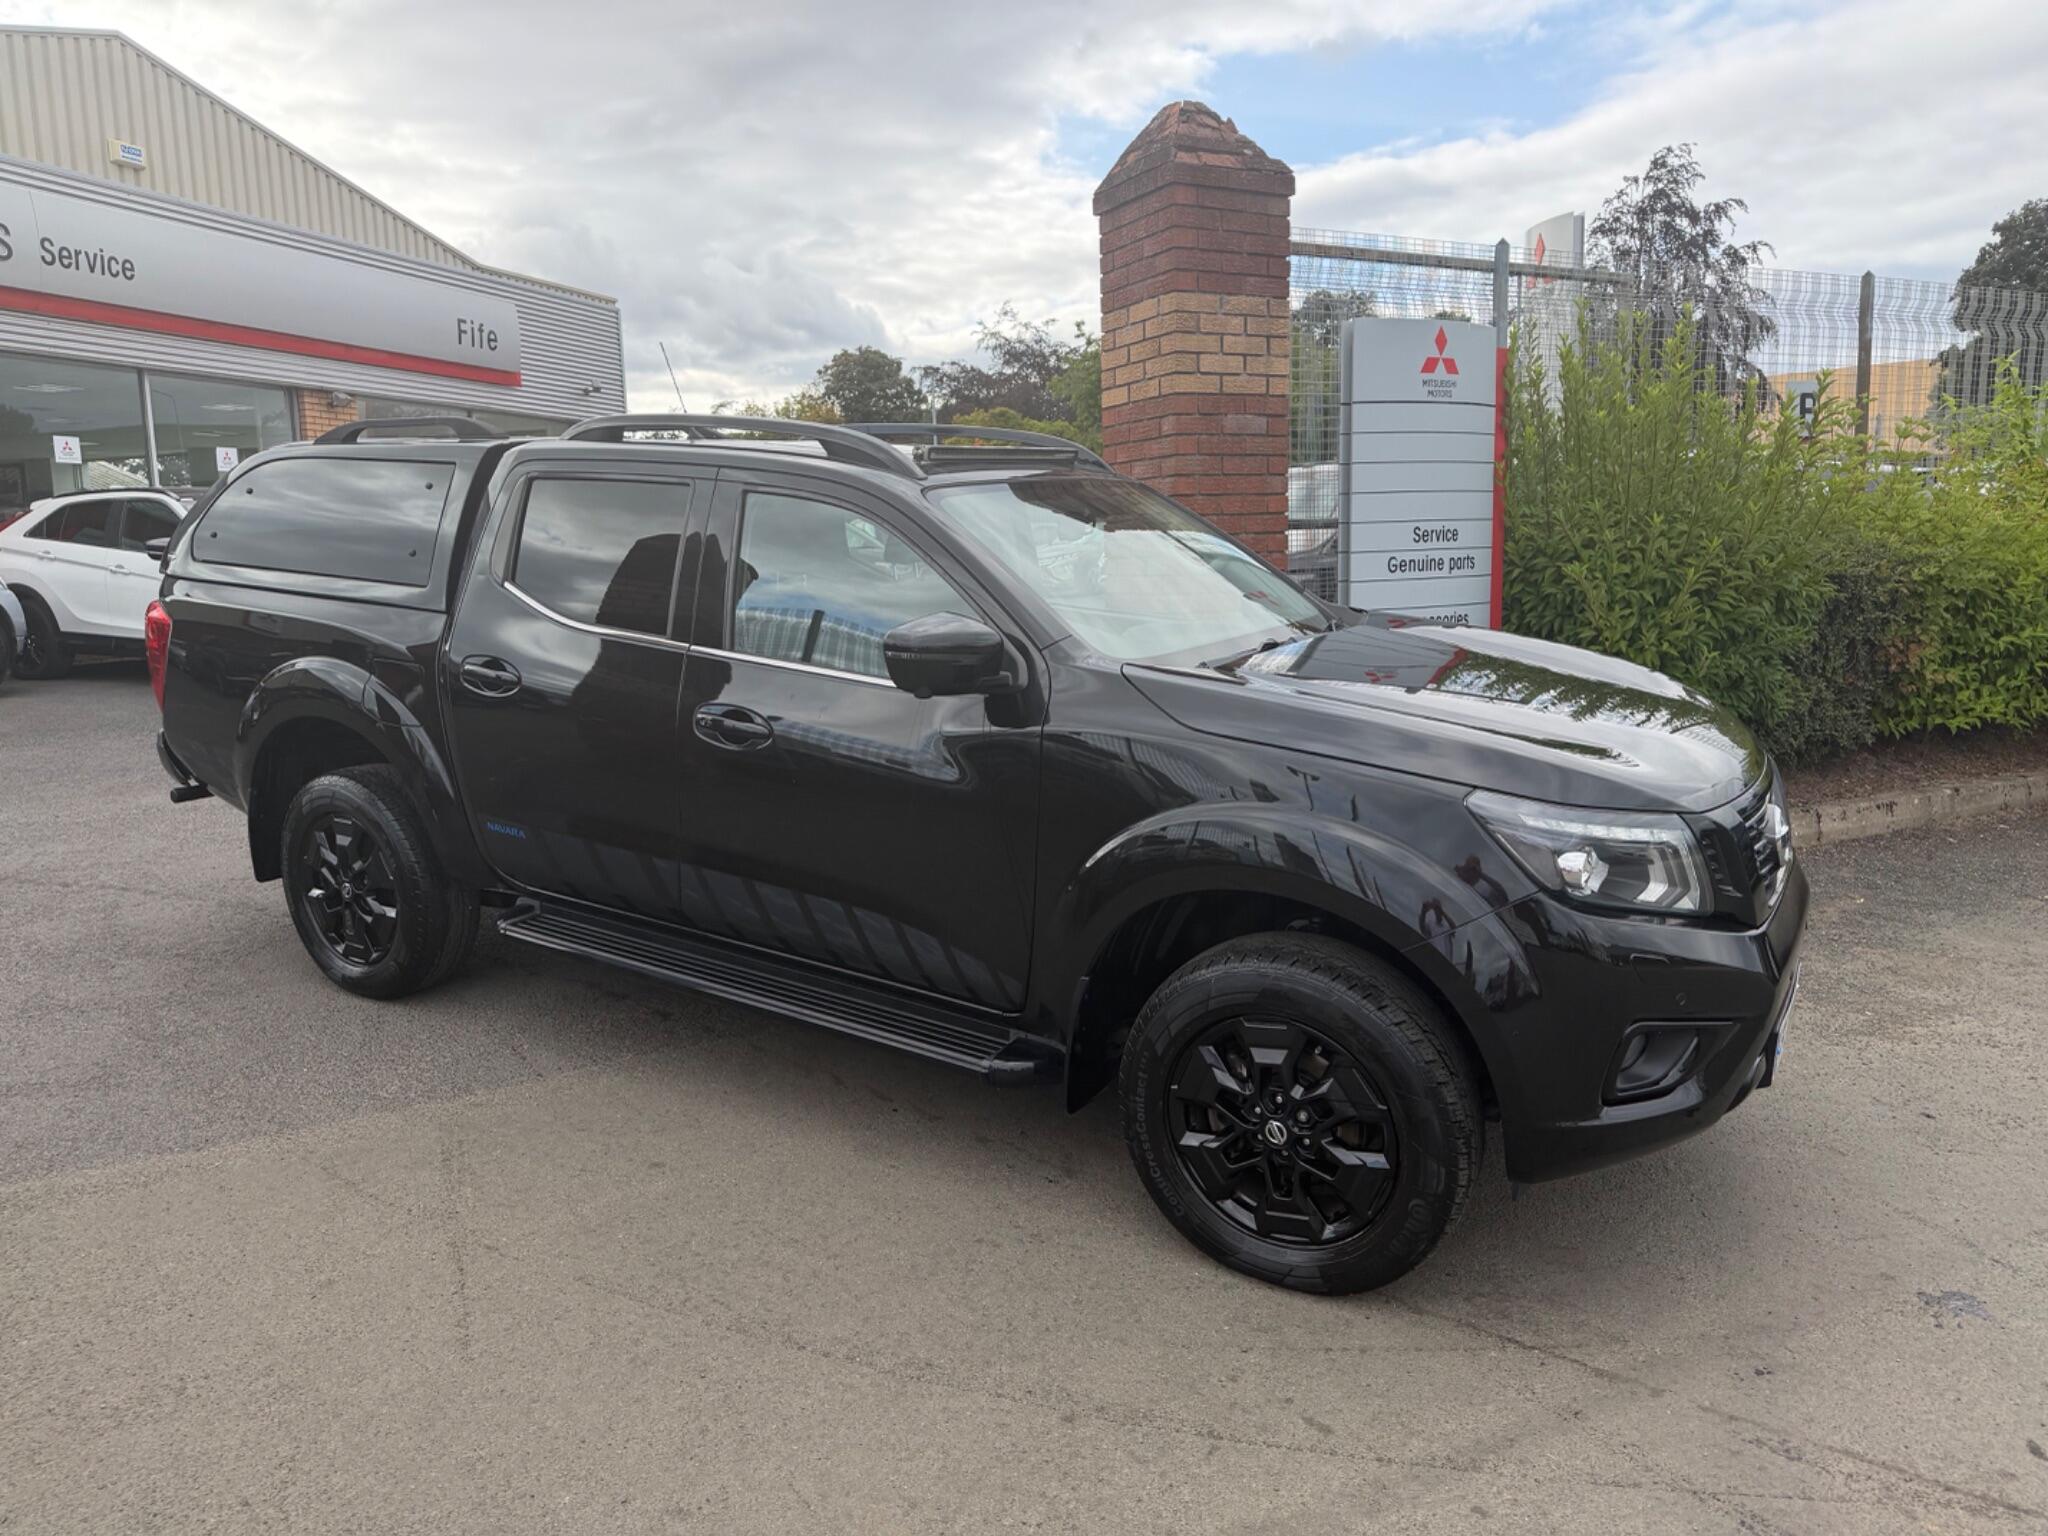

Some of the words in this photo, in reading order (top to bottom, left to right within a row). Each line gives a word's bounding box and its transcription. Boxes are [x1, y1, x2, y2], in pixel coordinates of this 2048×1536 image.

[40, 237, 136, 281] Service
[457, 318, 498, 351] Fife
[1427, 389, 1453, 399] MOTORS
[1412, 525, 1459, 543] Service
[1387, 555, 1444, 573] Genuine
[1448, 554, 1475, 574] parts
[487, 821, 526, 839] NAVARA
